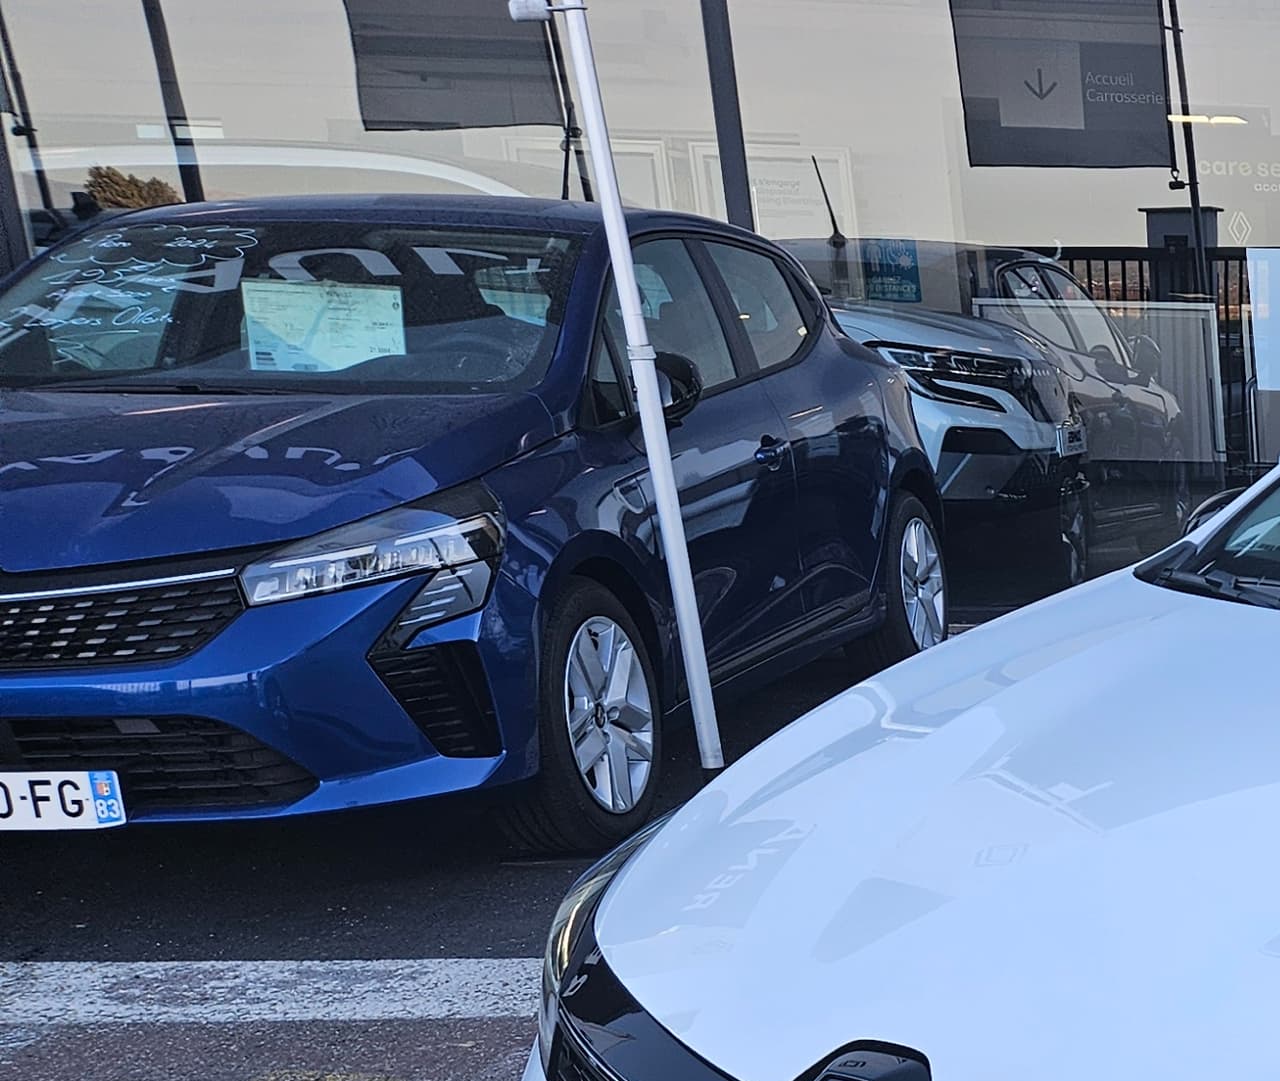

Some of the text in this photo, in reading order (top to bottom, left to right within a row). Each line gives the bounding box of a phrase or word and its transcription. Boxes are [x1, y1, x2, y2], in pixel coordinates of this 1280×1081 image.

[1085, 71, 1134, 86] Accueil
[1086, 88, 1163, 104] Carrosserie
[1199, 159, 1252, 177] care
[95, 798, 121, 819] 83
